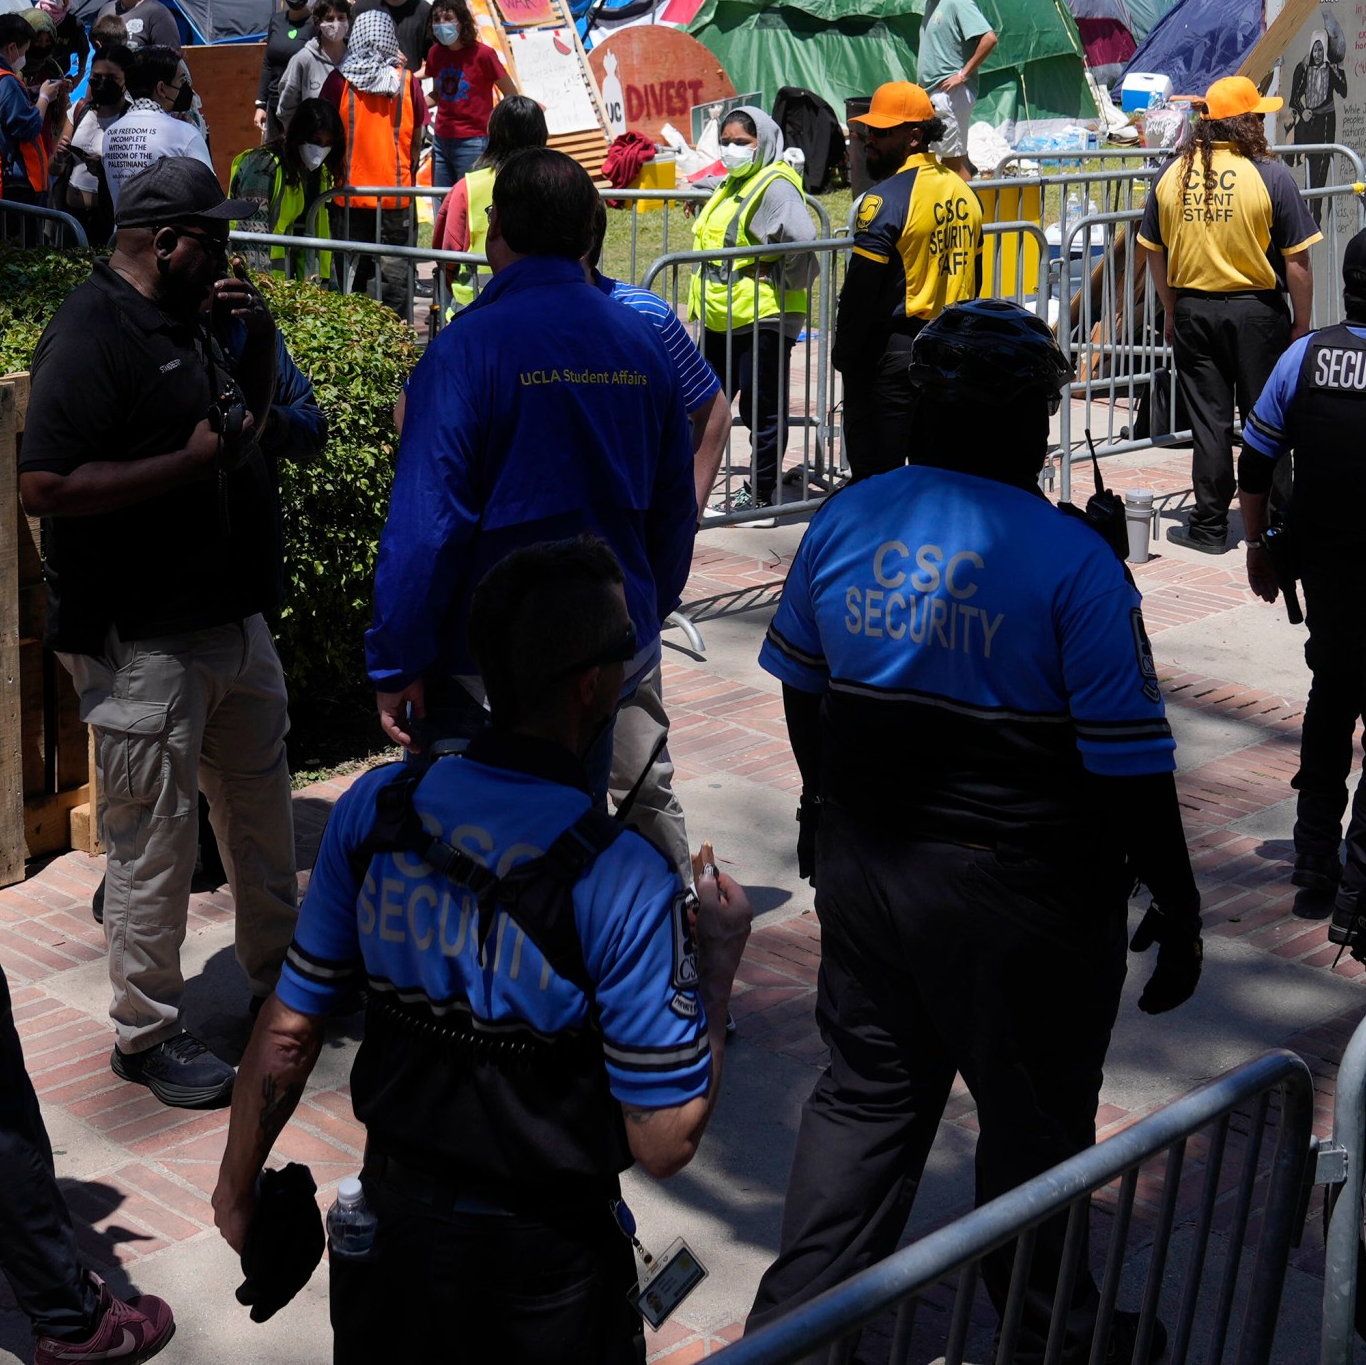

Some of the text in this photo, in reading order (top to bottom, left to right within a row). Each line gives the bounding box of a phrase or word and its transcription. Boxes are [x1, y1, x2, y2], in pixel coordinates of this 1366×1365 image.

[1355, 4, 1362, 14] In
[625, 79, 704, 123] DIVEST
[1343, 104, 1361, 115] While
[1342, 117, 1365, 128] peoples
[107, 128, 118, 136] OUR
[118, 127, 148, 135] FREEDOM
[110, 135, 146, 143] INCOMPLETE
[135, 143, 147, 151] THE
[140, 152, 153, 160] THE
[1183, 169, 1237, 190] CSC
[1183, 193, 1234, 206] EVENT
[933, 198, 969, 226] CSC
[1183, 208, 1234, 222] STAFF
[520, 369, 648, 386] UCLA Student Affairs
[873, 540, 985, 600] CSC
[844, 586, 1005, 659] SECURITY
